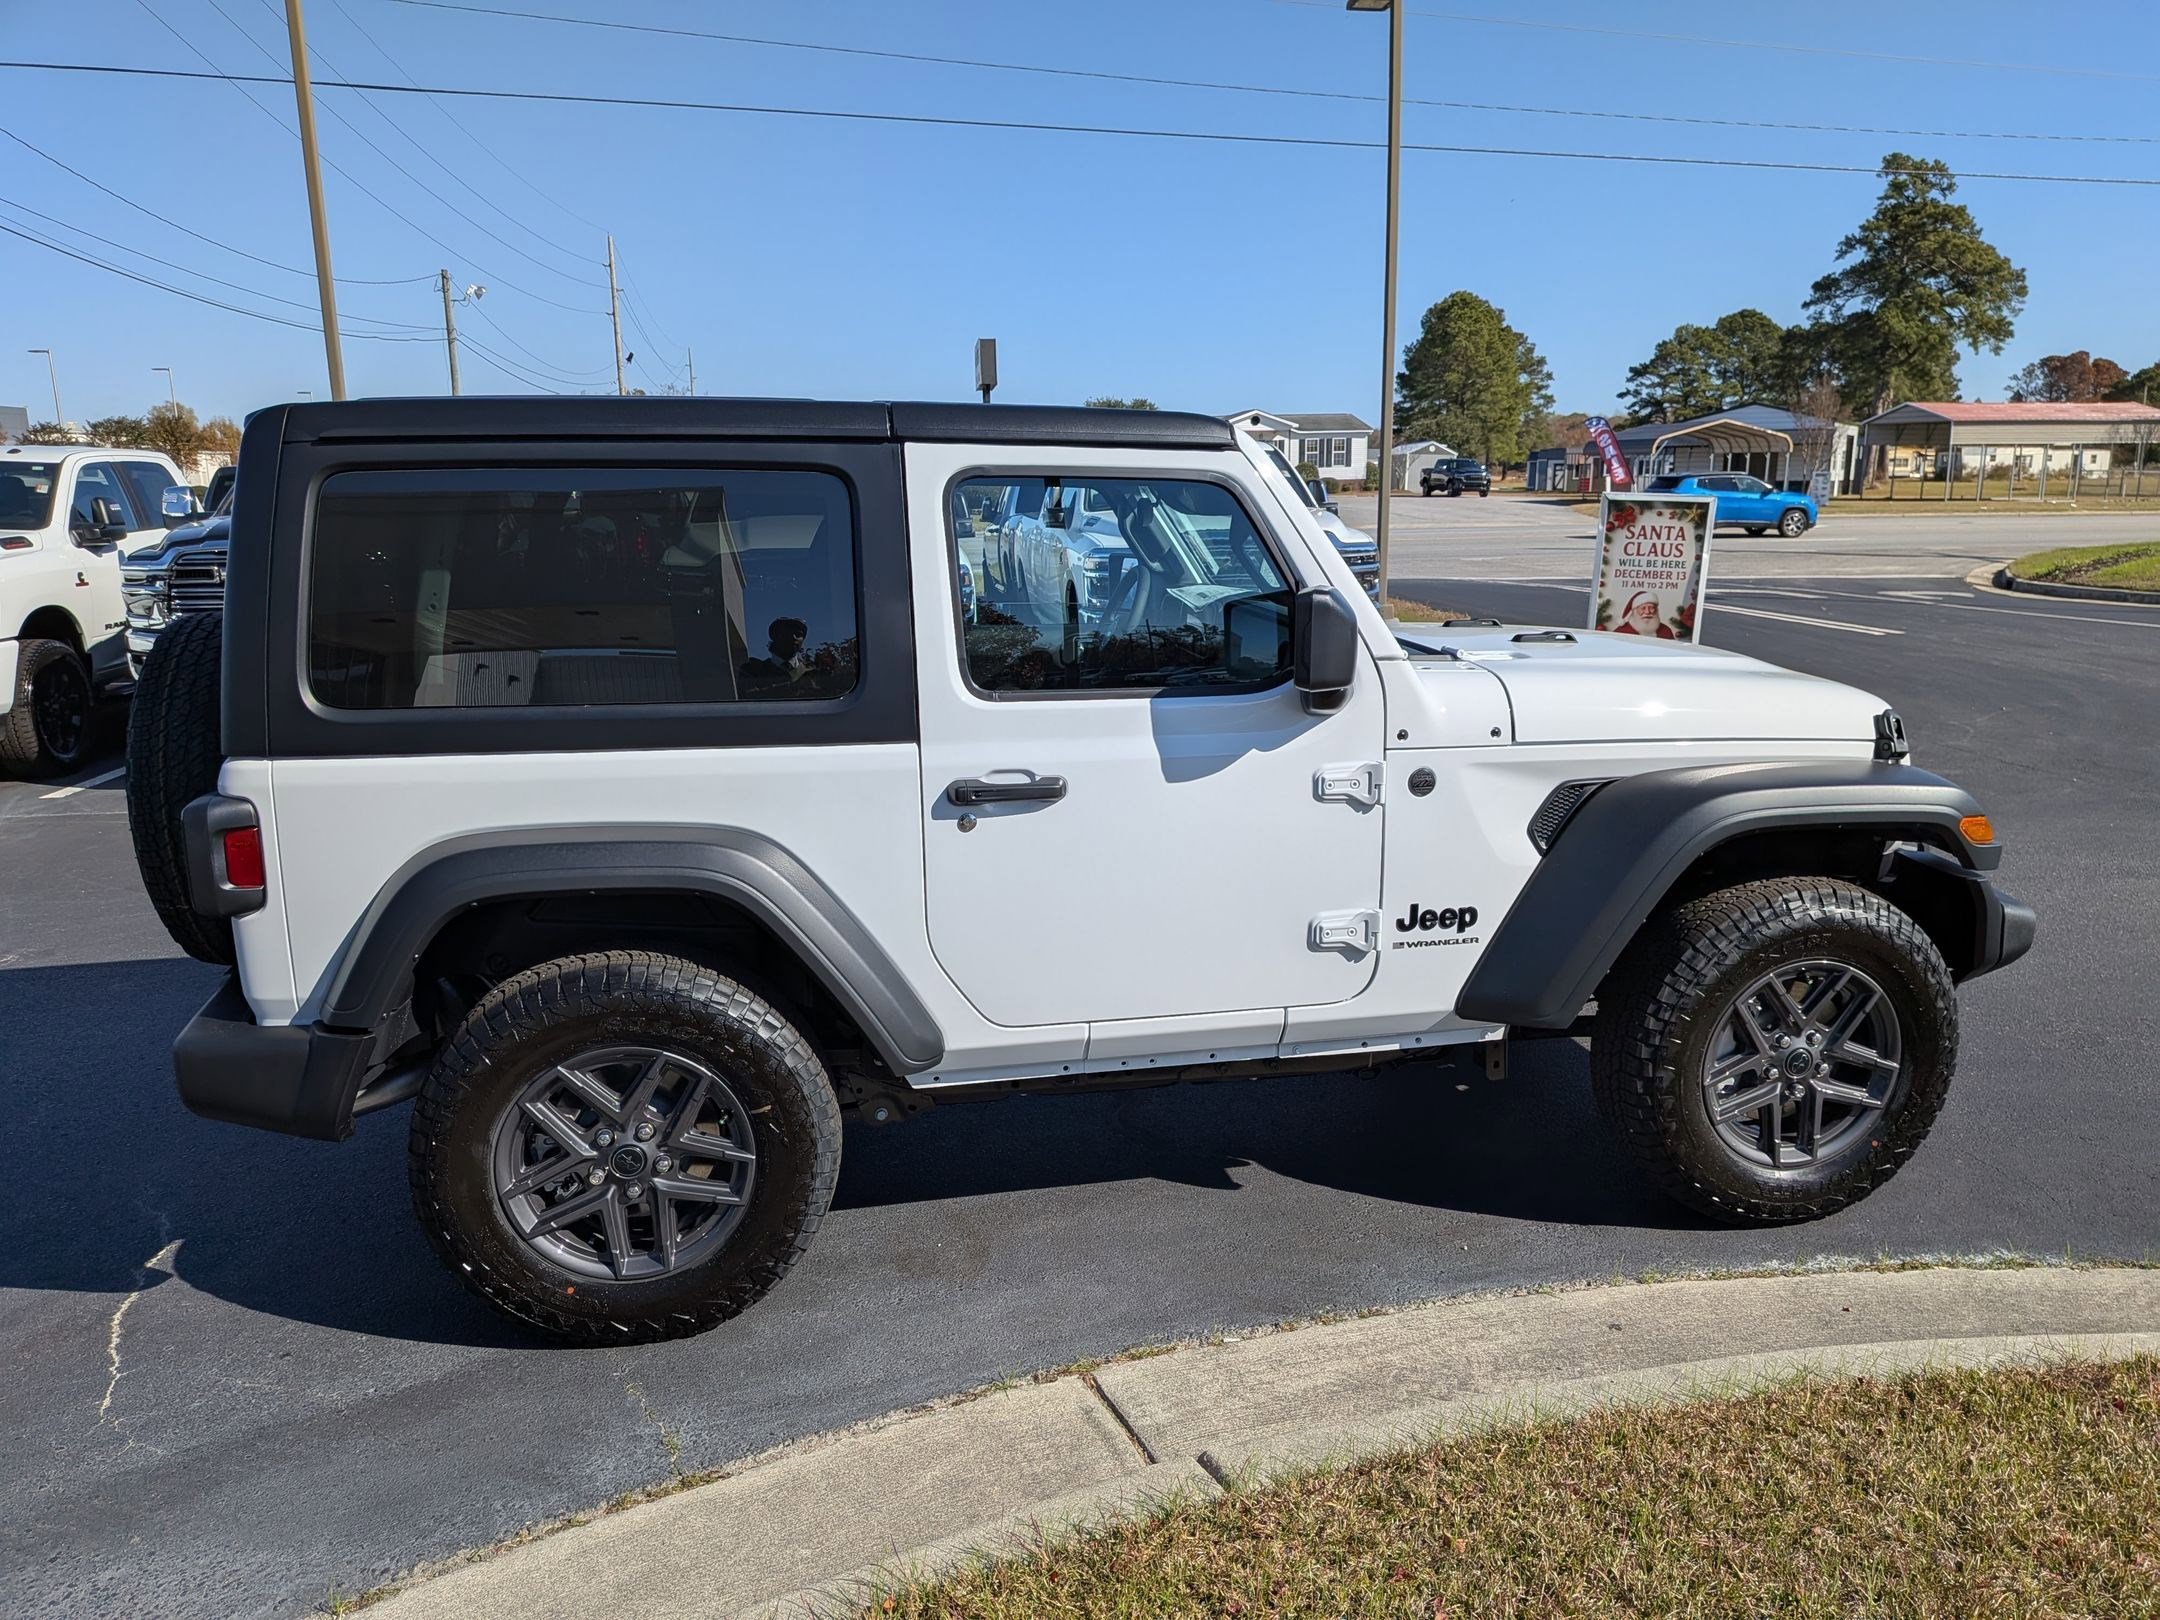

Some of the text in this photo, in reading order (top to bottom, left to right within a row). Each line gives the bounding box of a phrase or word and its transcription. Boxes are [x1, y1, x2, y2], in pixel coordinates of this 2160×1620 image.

[1625, 525, 1686, 541] SANTA
[1623, 542, 1684, 558] CLAUS
[1619, 558, 1686, 569] WILL BE HERE
[1614, 569, 1686, 580] DECEMBER 13
[1665, 582, 1679, 590] PM
[1396, 903, 1478, 934] Jeep
[1406, 937, 1480, 948] WRANGLER
